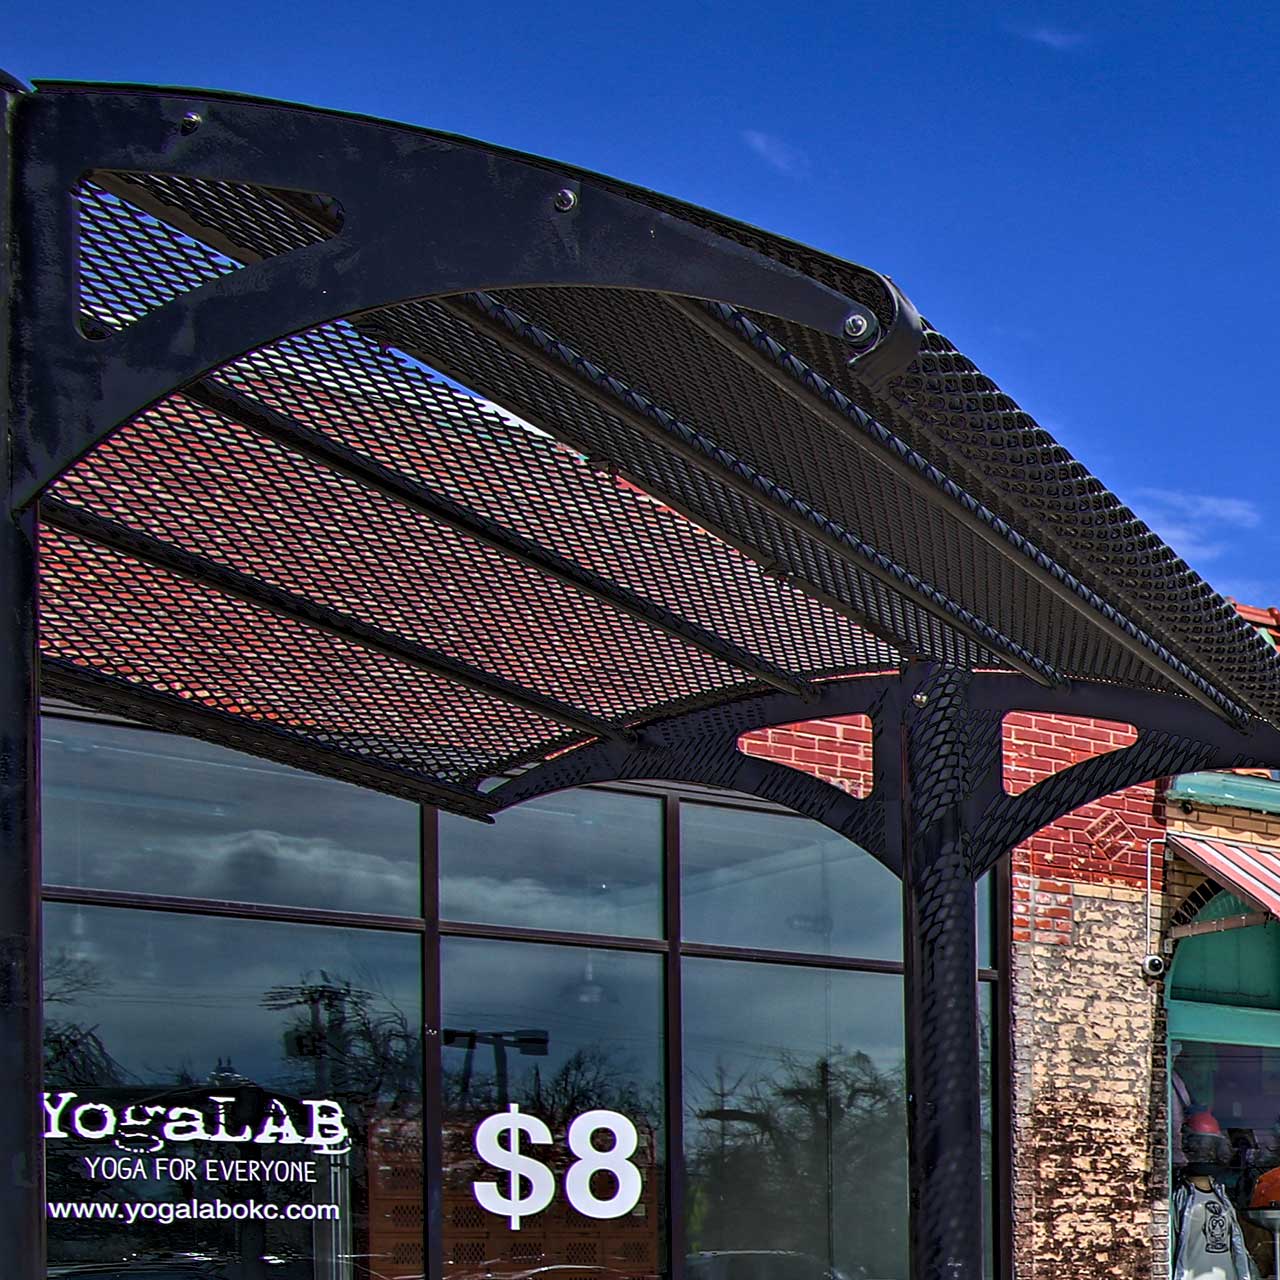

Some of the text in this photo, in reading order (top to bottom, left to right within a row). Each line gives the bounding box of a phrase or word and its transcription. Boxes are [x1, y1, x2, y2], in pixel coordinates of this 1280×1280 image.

[85, 1156, 318, 1183] YOGA FOR EVERYONE
[473, 1103, 643, 1231] $8
[48, 1199, 341, 1224] www.yogalabokc.com
